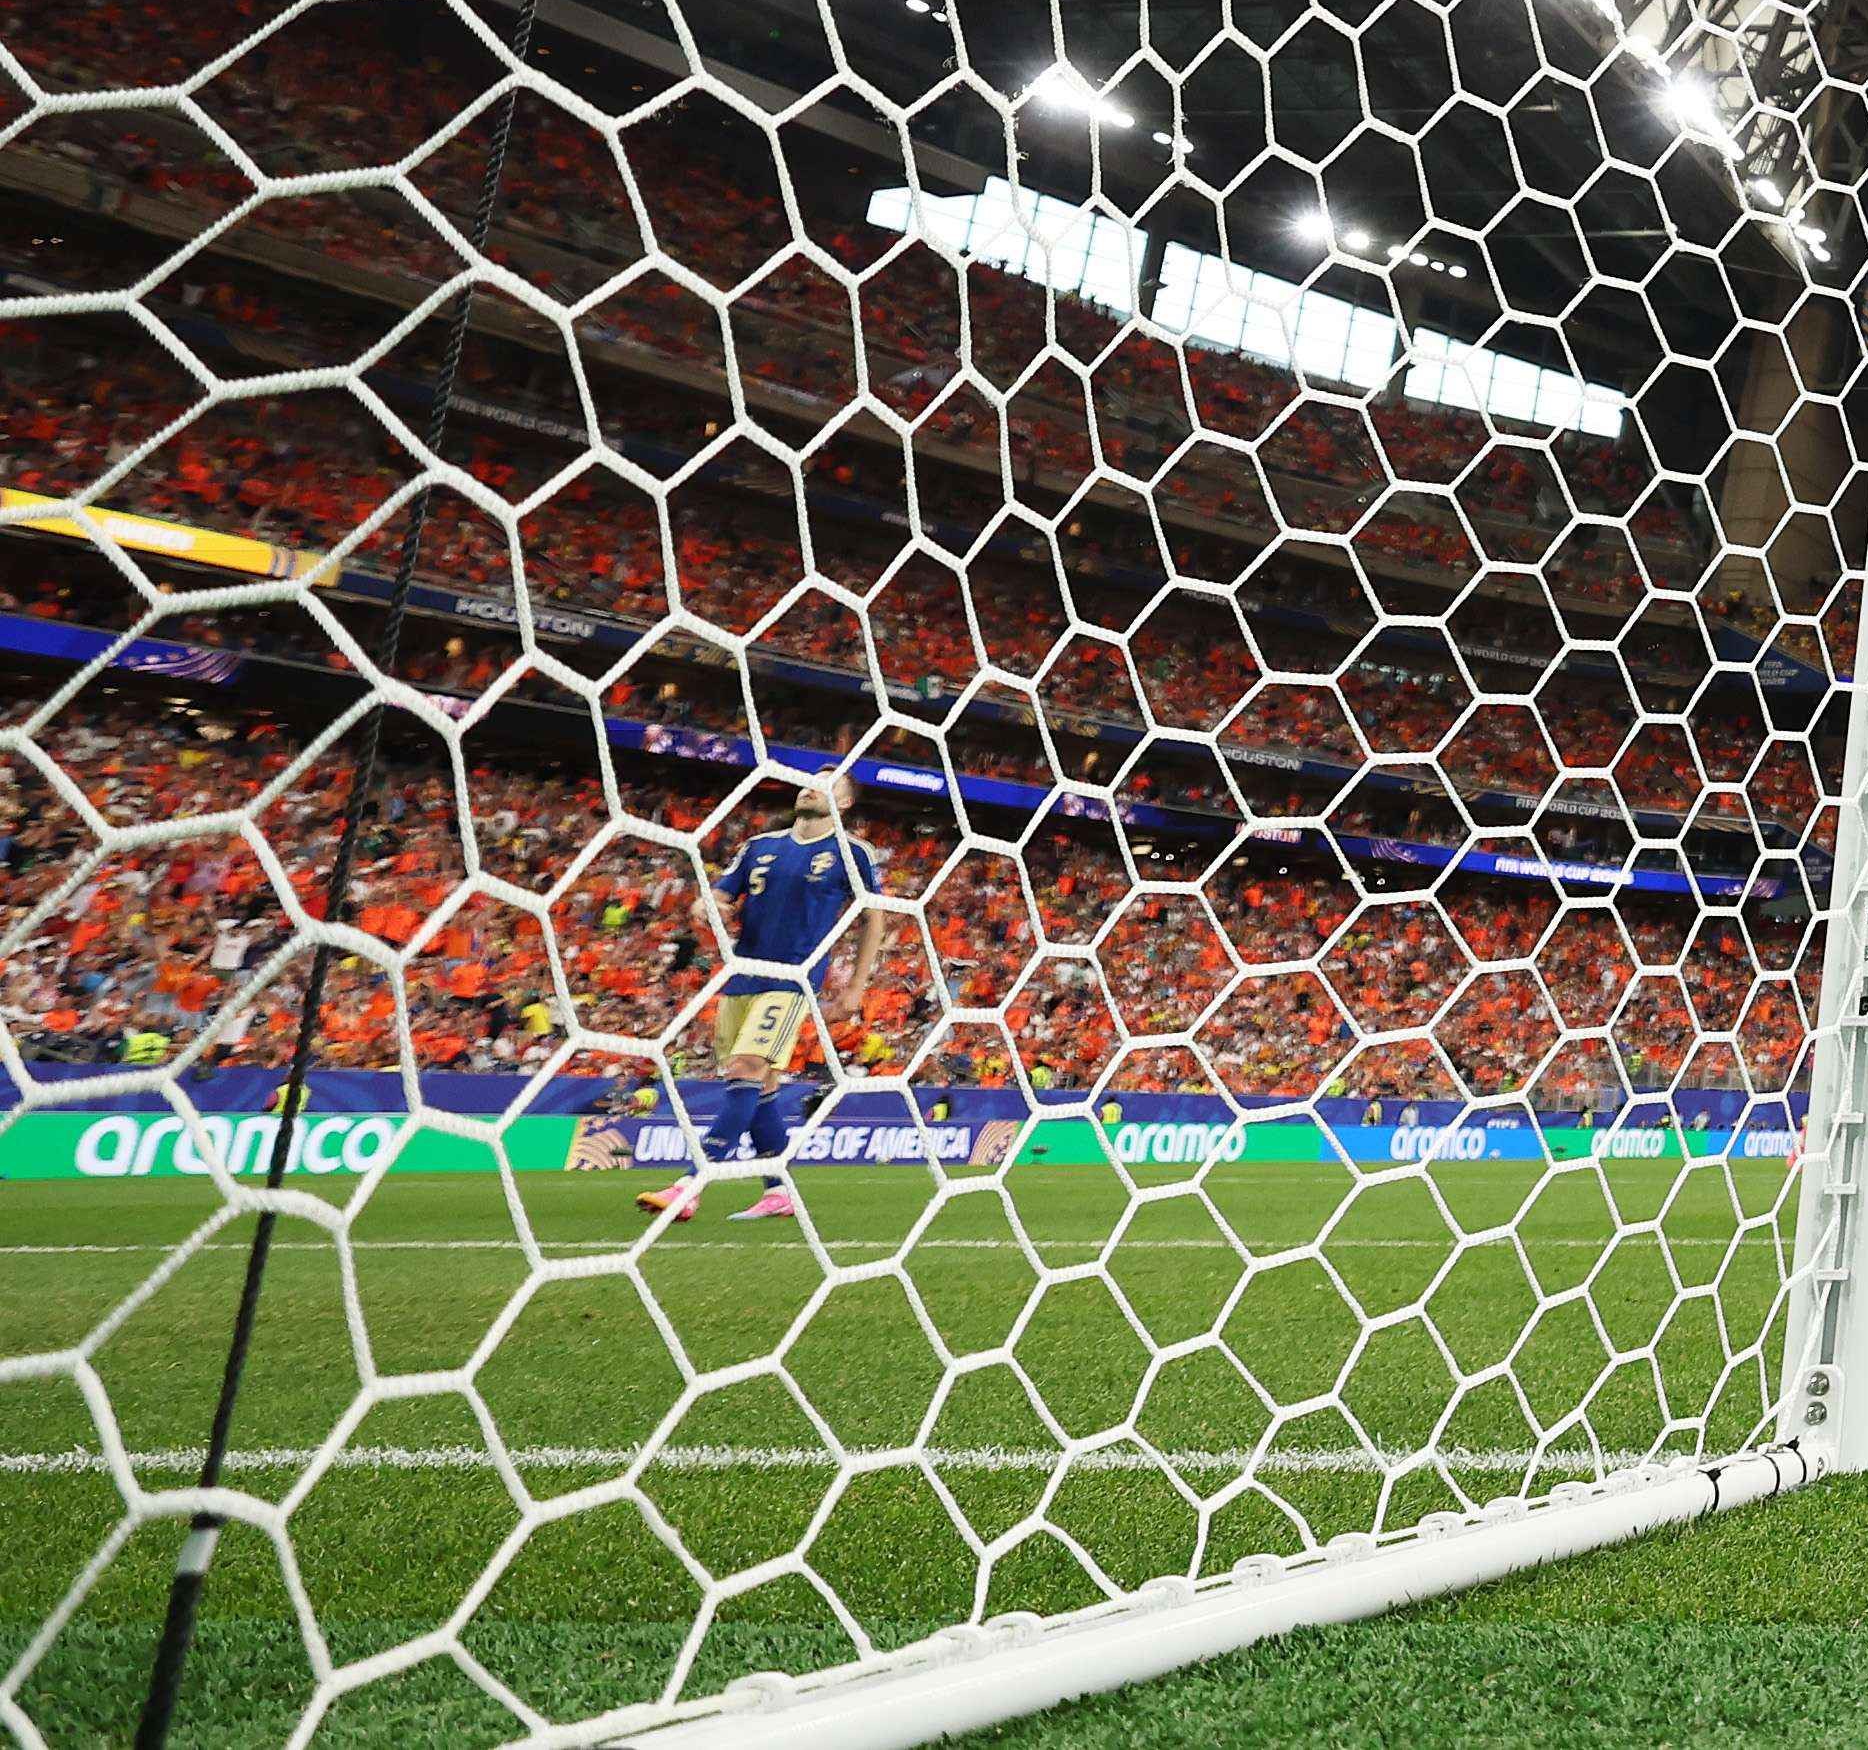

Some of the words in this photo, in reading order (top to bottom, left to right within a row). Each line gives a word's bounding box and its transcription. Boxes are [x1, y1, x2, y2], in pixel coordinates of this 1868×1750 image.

[454, 597, 597, 638] HOUTON
[1543, 800, 1577, 815] ORLD
[1577, 806, 1599, 817] CUP
[749, 866, 770, 895] 5
[1519, 860, 1566, 879] WORD
[1564, 865, 1590, 881] CUP
[761, 1005, 783, 1030] 5
[74, 1114, 396, 1174] aramco
[831, 1126, 871, 1160] OF
